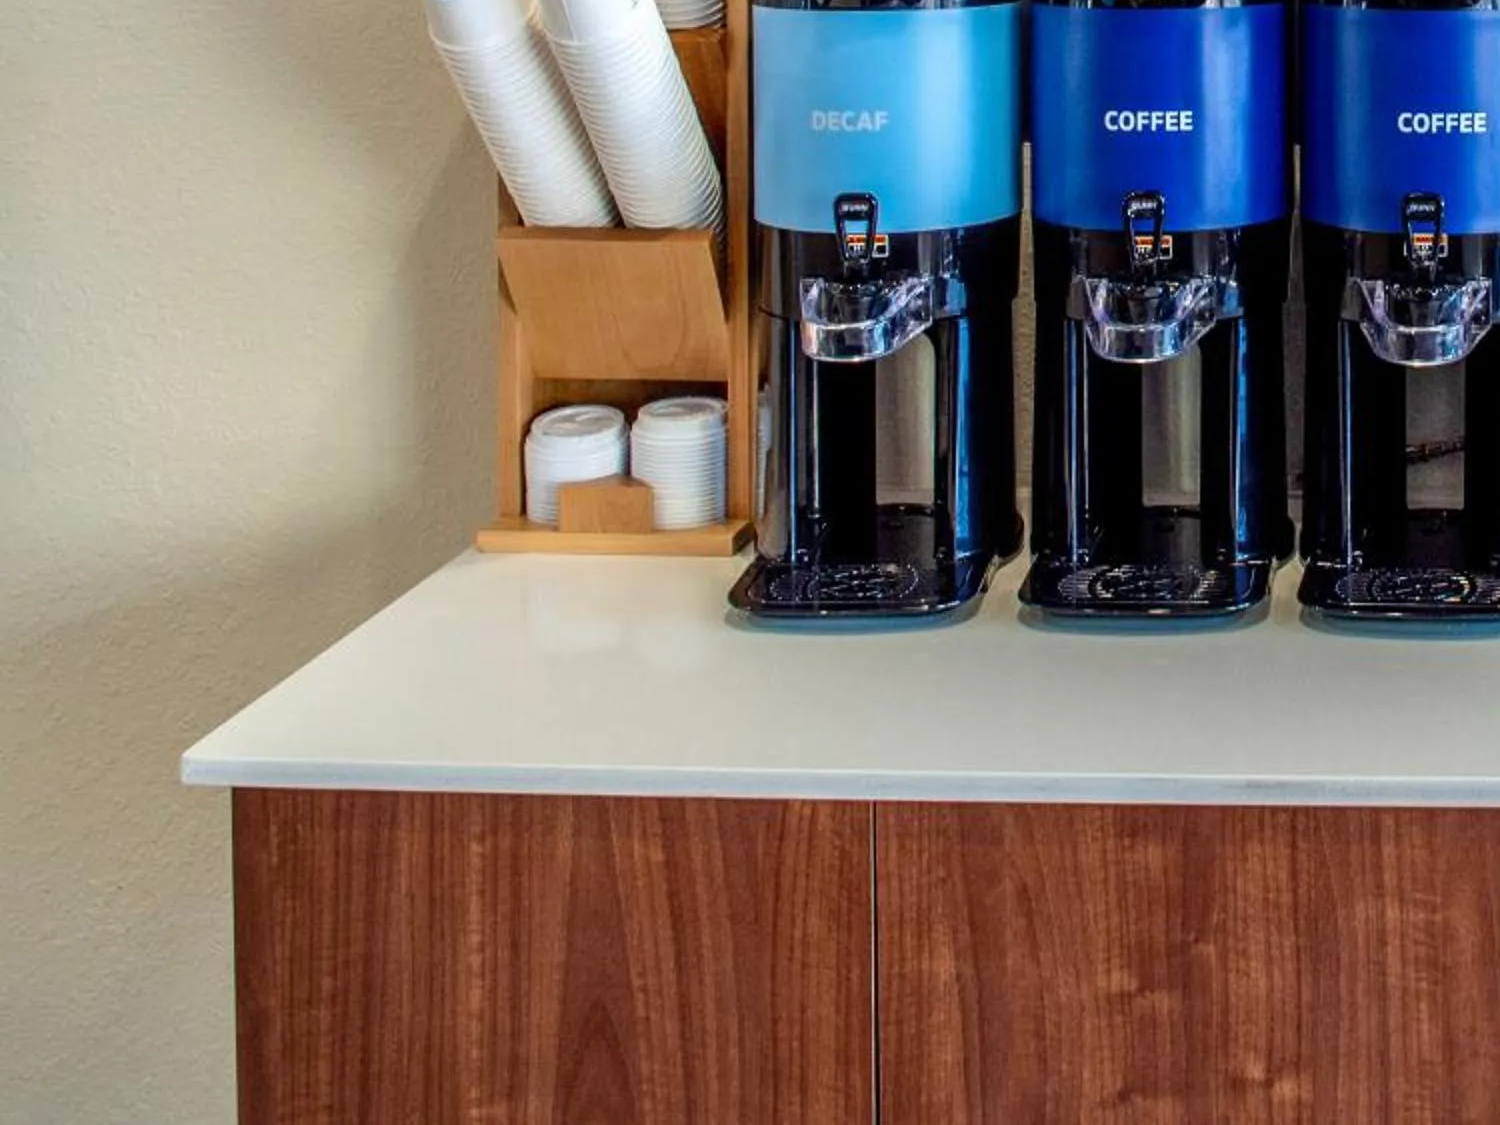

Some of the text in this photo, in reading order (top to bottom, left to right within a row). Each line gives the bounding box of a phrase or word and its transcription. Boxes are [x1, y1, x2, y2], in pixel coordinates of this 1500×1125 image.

[812, 110, 890, 132] DECAF
[1104, 110, 1194, 132] COFFEE
[1397, 112, 1488, 134] COFFEE
